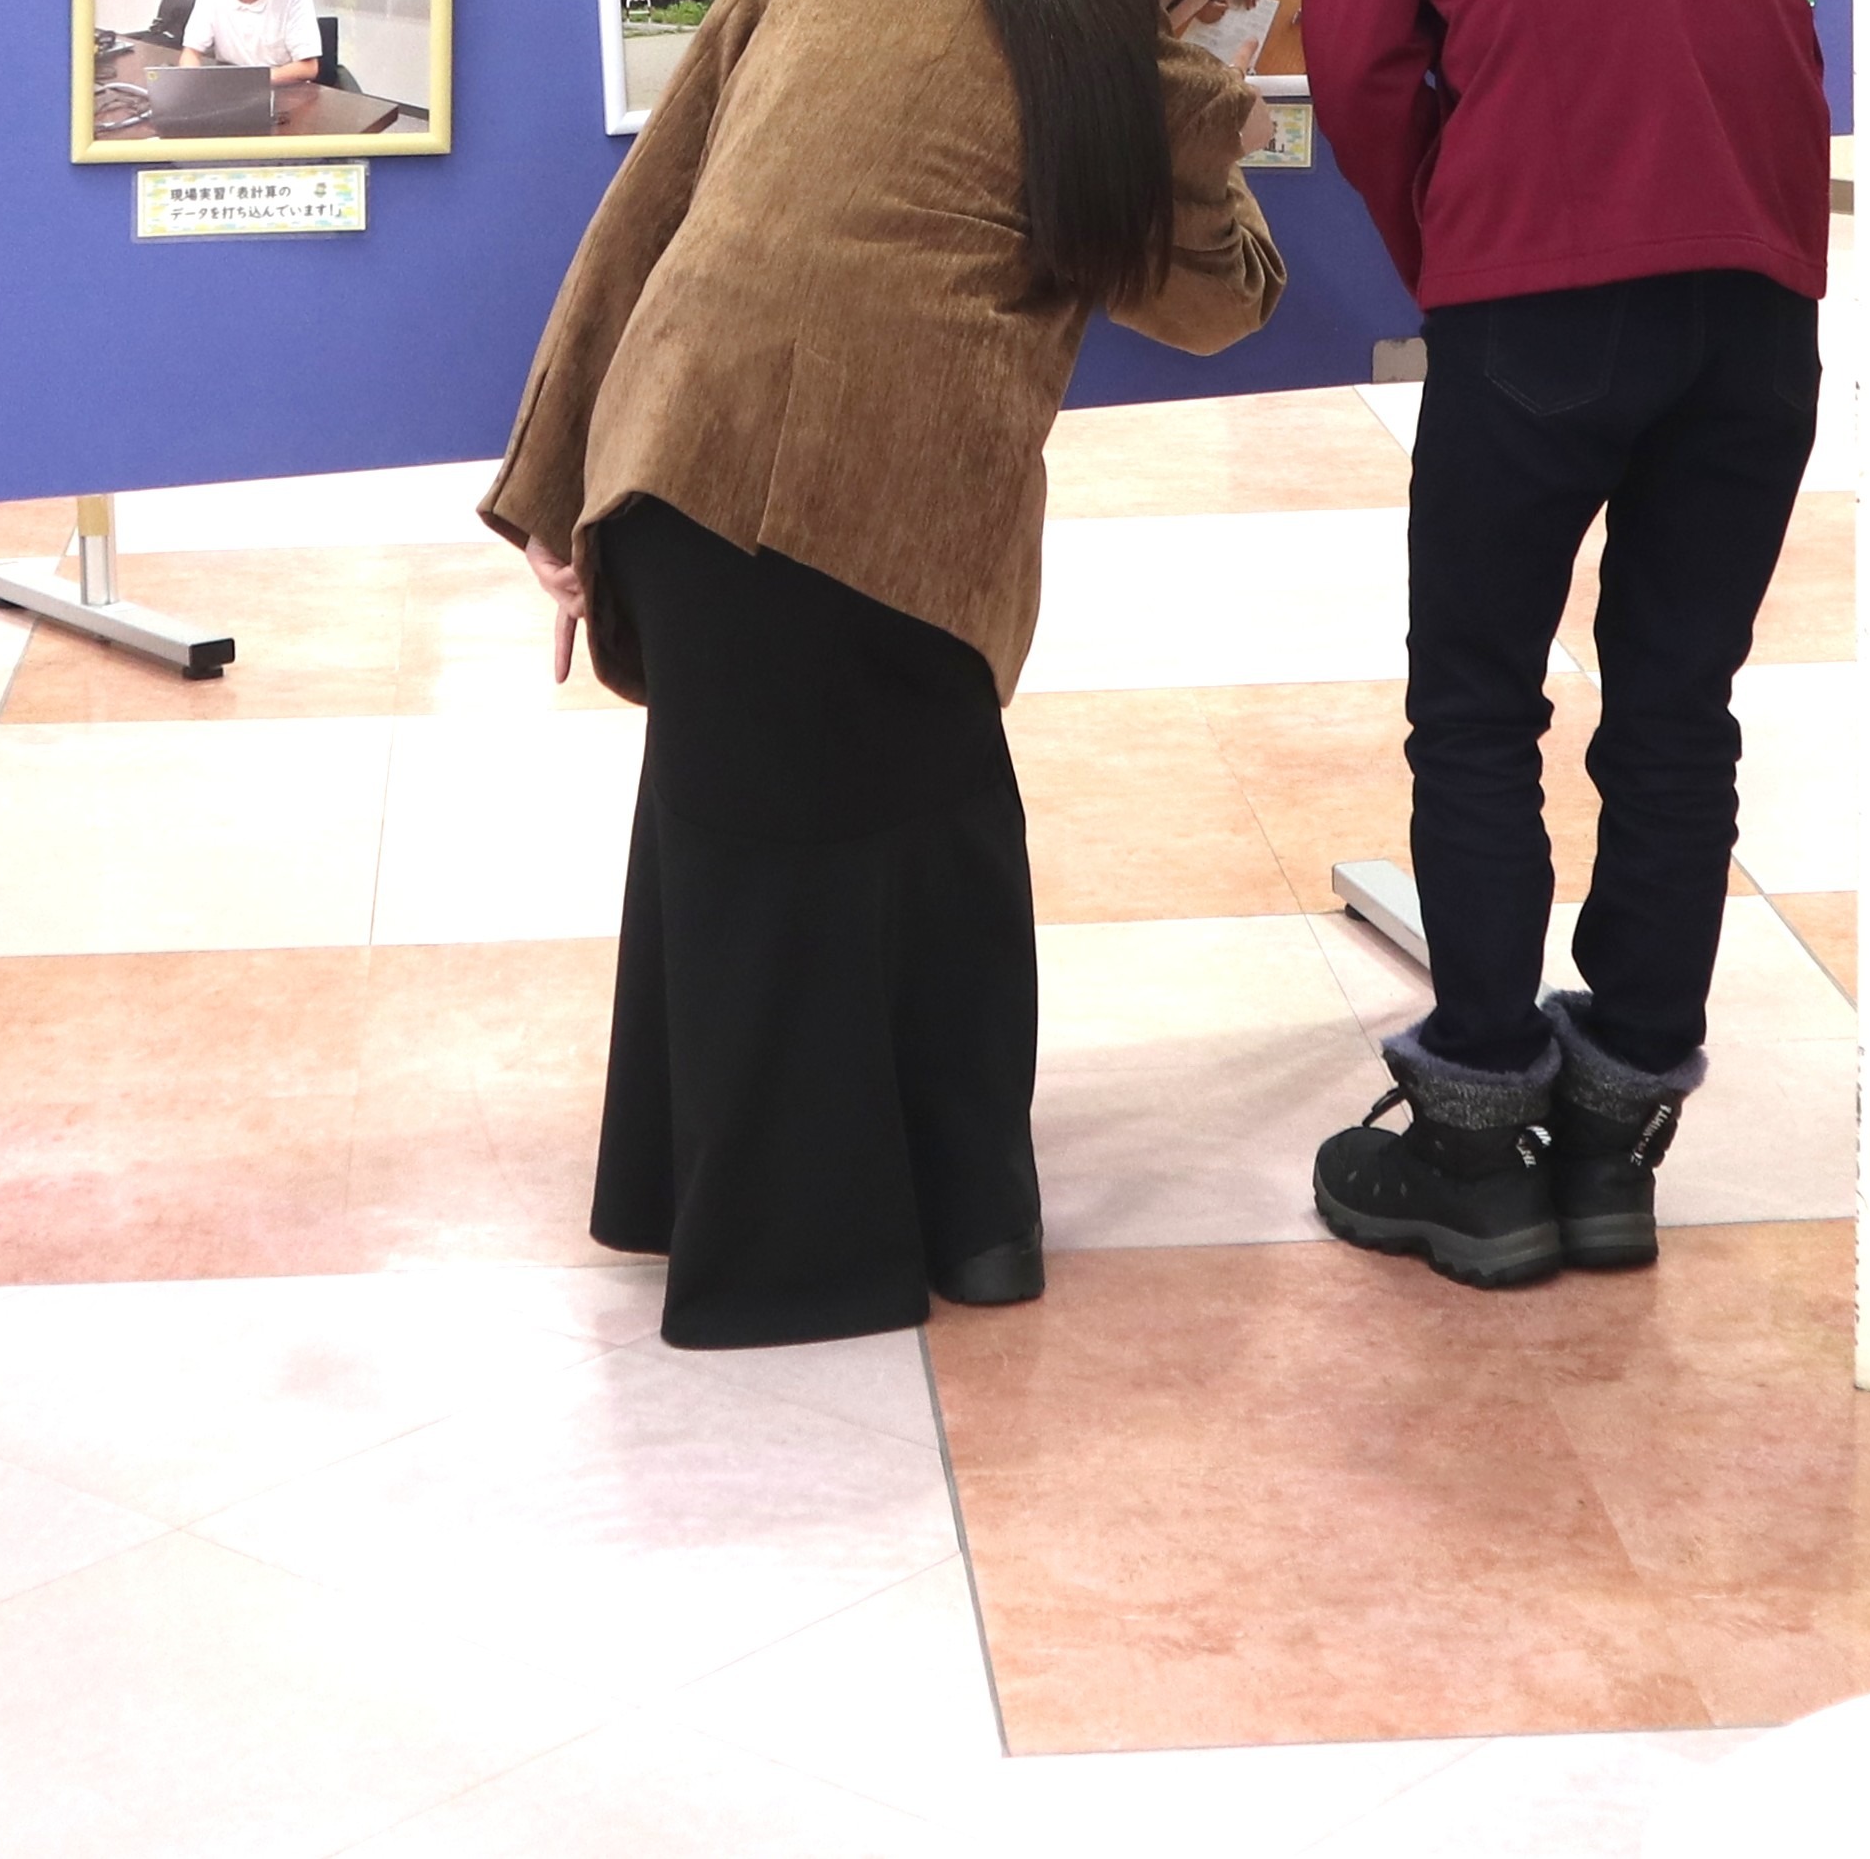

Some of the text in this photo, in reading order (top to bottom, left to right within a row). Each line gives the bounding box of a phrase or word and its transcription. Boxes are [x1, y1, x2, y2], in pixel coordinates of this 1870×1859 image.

[170, 185, 292, 202] 現場実習「表計算の
